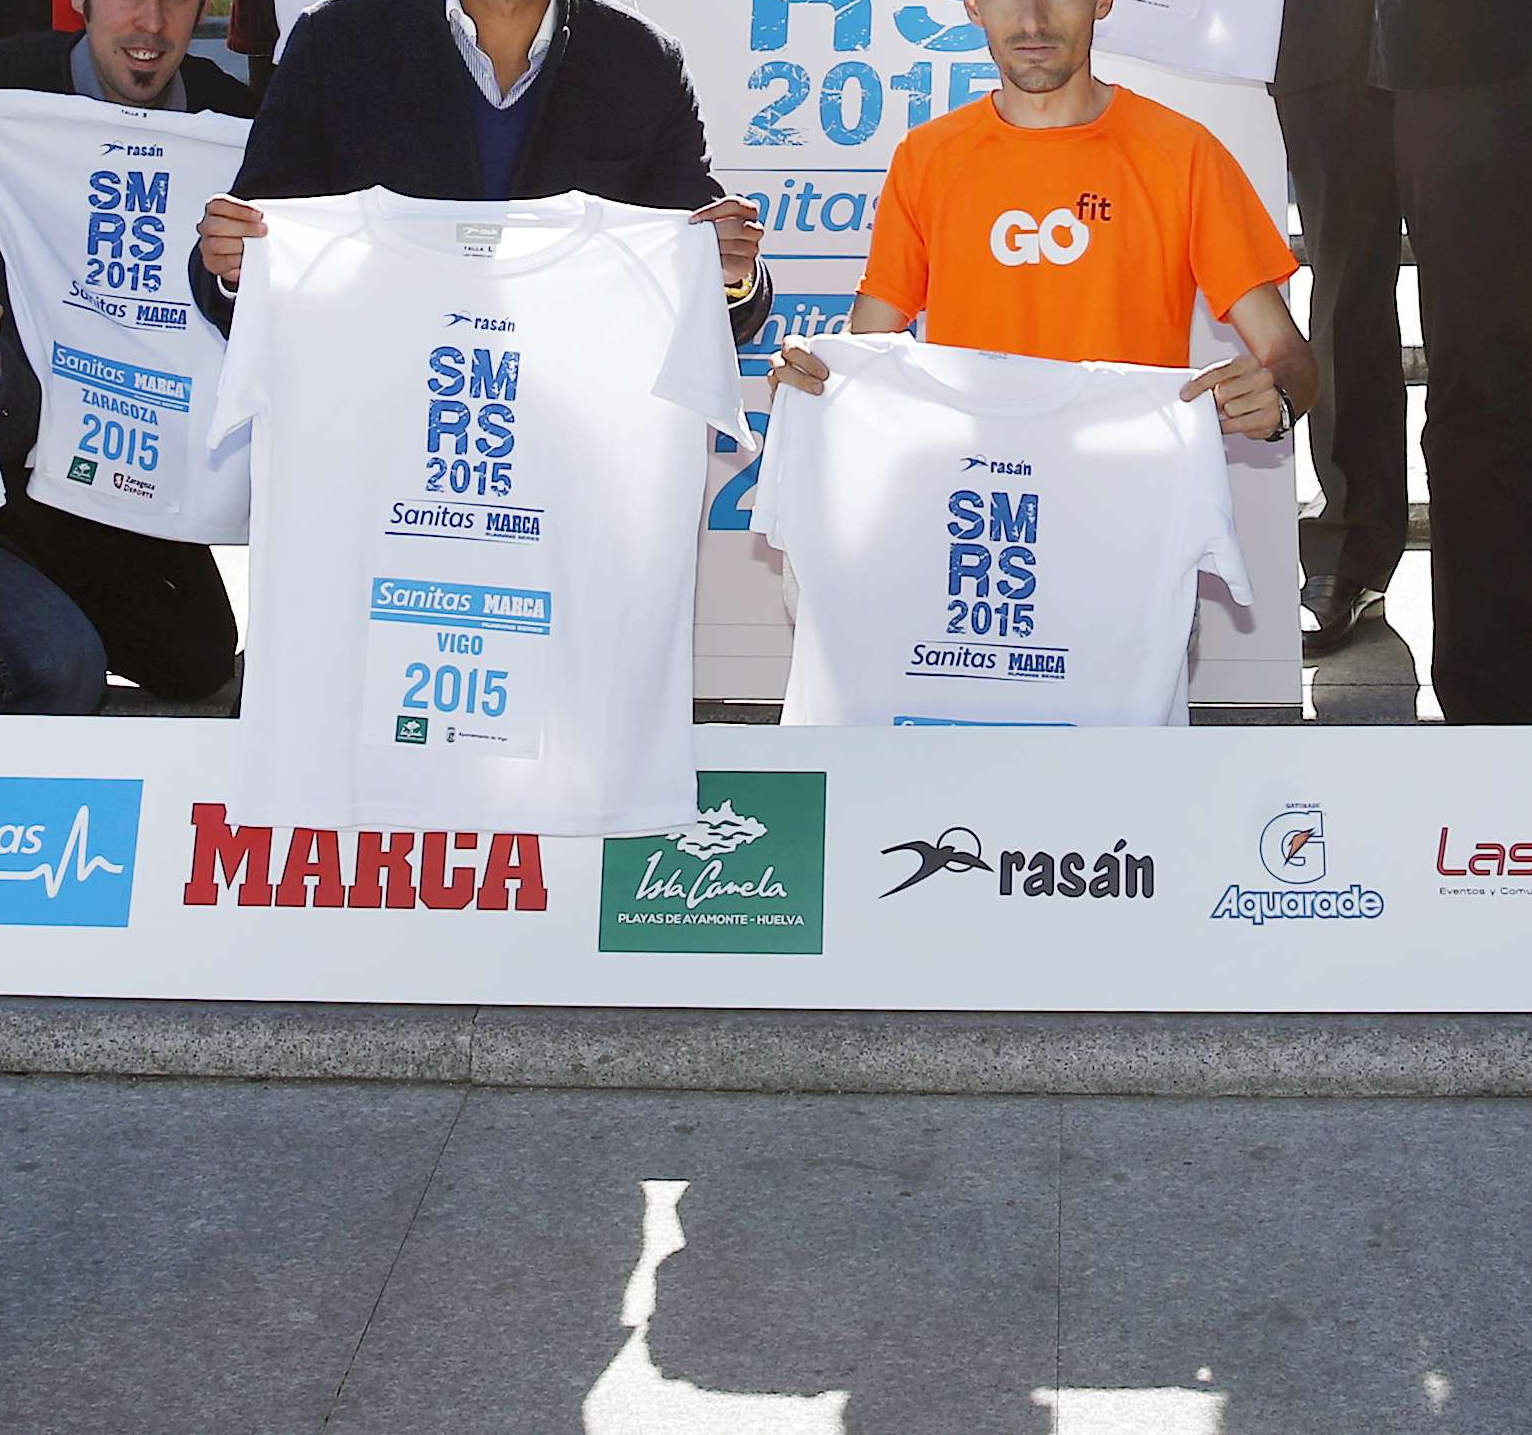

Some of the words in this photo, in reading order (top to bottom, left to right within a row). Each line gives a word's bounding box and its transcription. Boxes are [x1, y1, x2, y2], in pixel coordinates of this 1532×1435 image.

[126, 143, 164, 158] rasán
[87, 170, 170, 214] SM
[86, 212, 165, 262] RS
[989, 207, 1091, 267] GO
[1076, 192, 1112, 222] fit
[85, 258, 162, 293] 2015
[69, 280, 128, 318] Sanitas
[136, 304, 188, 325] MARCA
[474, 316, 516, 333] rasán
[55, 347, 125, 384] Sanitas
[133, 372, 186, 398] MARCA
[427, 345, 521, 401] SM
[81, 387, 158, 426] ZARAGOZA
[78, 413, 160, 472] 2015
[427, 399, 515, 459] RS
[425, 456, 513, 497] 2015
[990, 461, 1032, 477] rasán
[390, 502, 475, 529] Sanitas
[485, 512, 540, 536] MARCA
[947, 490, 1039, 544] SM
[947, 543, 1037, 600] RS
[376, 581, 472, 612] Sanitas
[482, 593, 546, 619] MARCA
[946, 599, 1035, 638] 2015
[436, 632, 484, 656] VIGO
[910, 643, 997, 669] Sanitas
[1008, 652, 1065, 674] MARCA
[402, 662, 510, 717] 2015
[183, 802, 549, 912] MARCA
[999, 838, 1155, 899] rasán
[635, 850, 687, 901] Isla
[685, 859, 788, 909] Canela
[1439, 886, 1486, 896] Eventos
[1489, 887, 1495, 896] y
[617, 912, 665, 925] PLAYAS
[666, 912, 682, 925] DE
[682, 913, 748, 926] AYAMONTE
[756, 914, 805, 927] HUELVA
[1210, 884, 1385, 926] Aquarade
